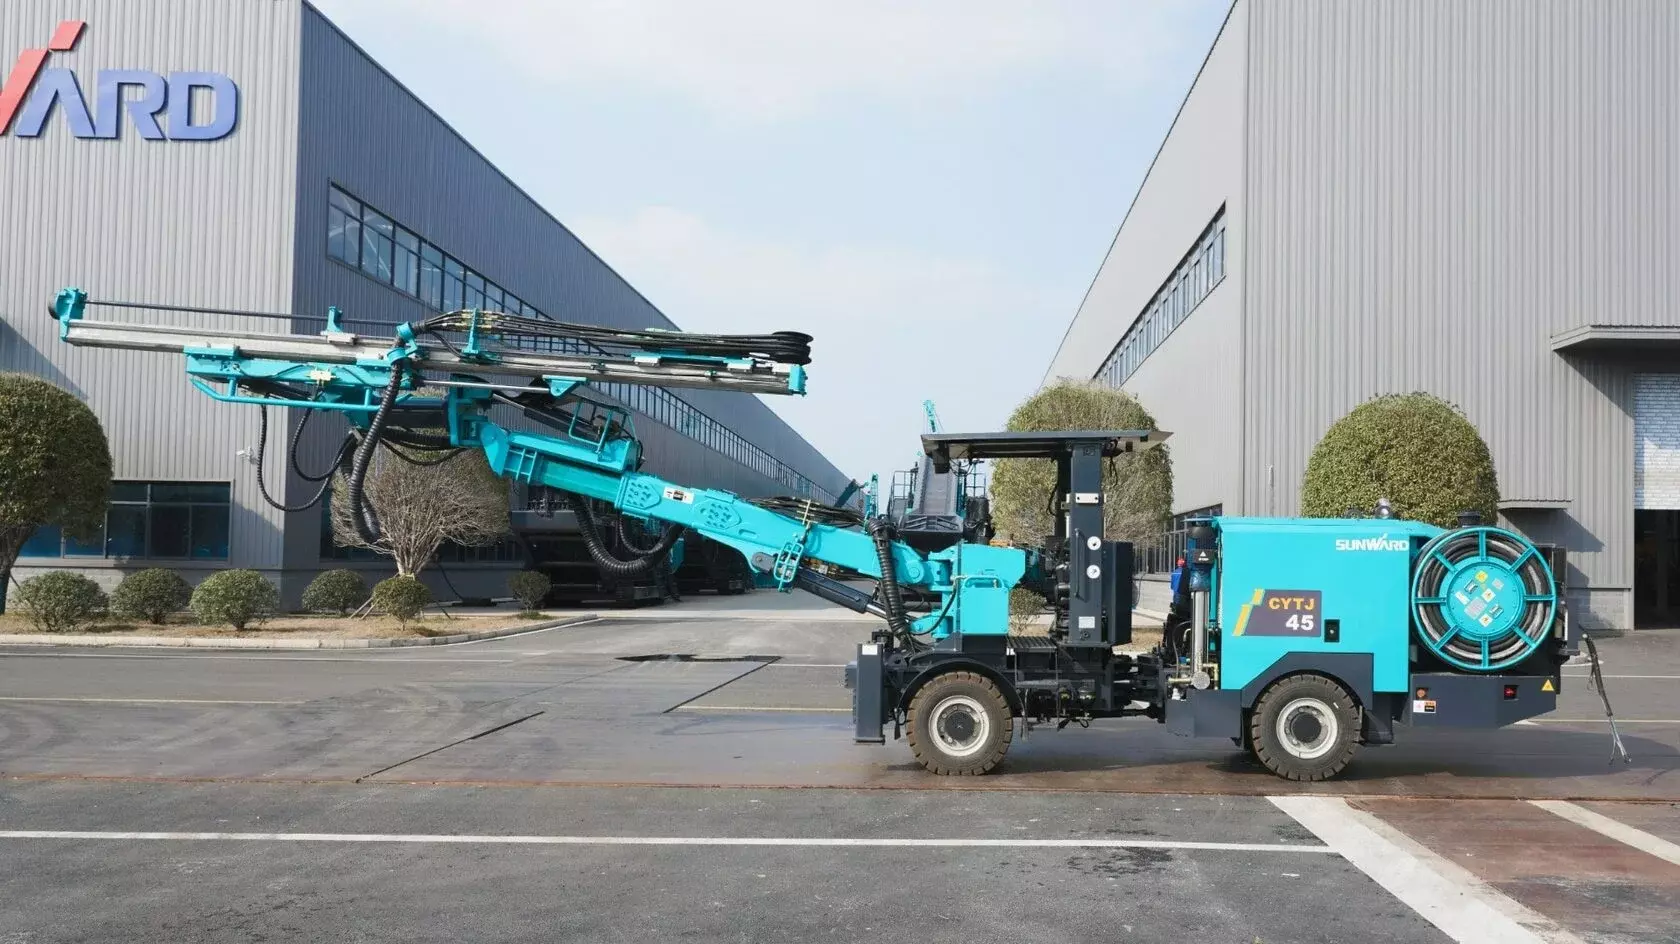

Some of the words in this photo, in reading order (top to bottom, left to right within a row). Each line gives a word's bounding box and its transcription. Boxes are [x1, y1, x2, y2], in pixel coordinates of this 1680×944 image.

[1335, 533, 1410, 551] SUNWARD
[1268, 597, 1315, 610] CYTJ
[1285, 614, 1315, 631] 45
